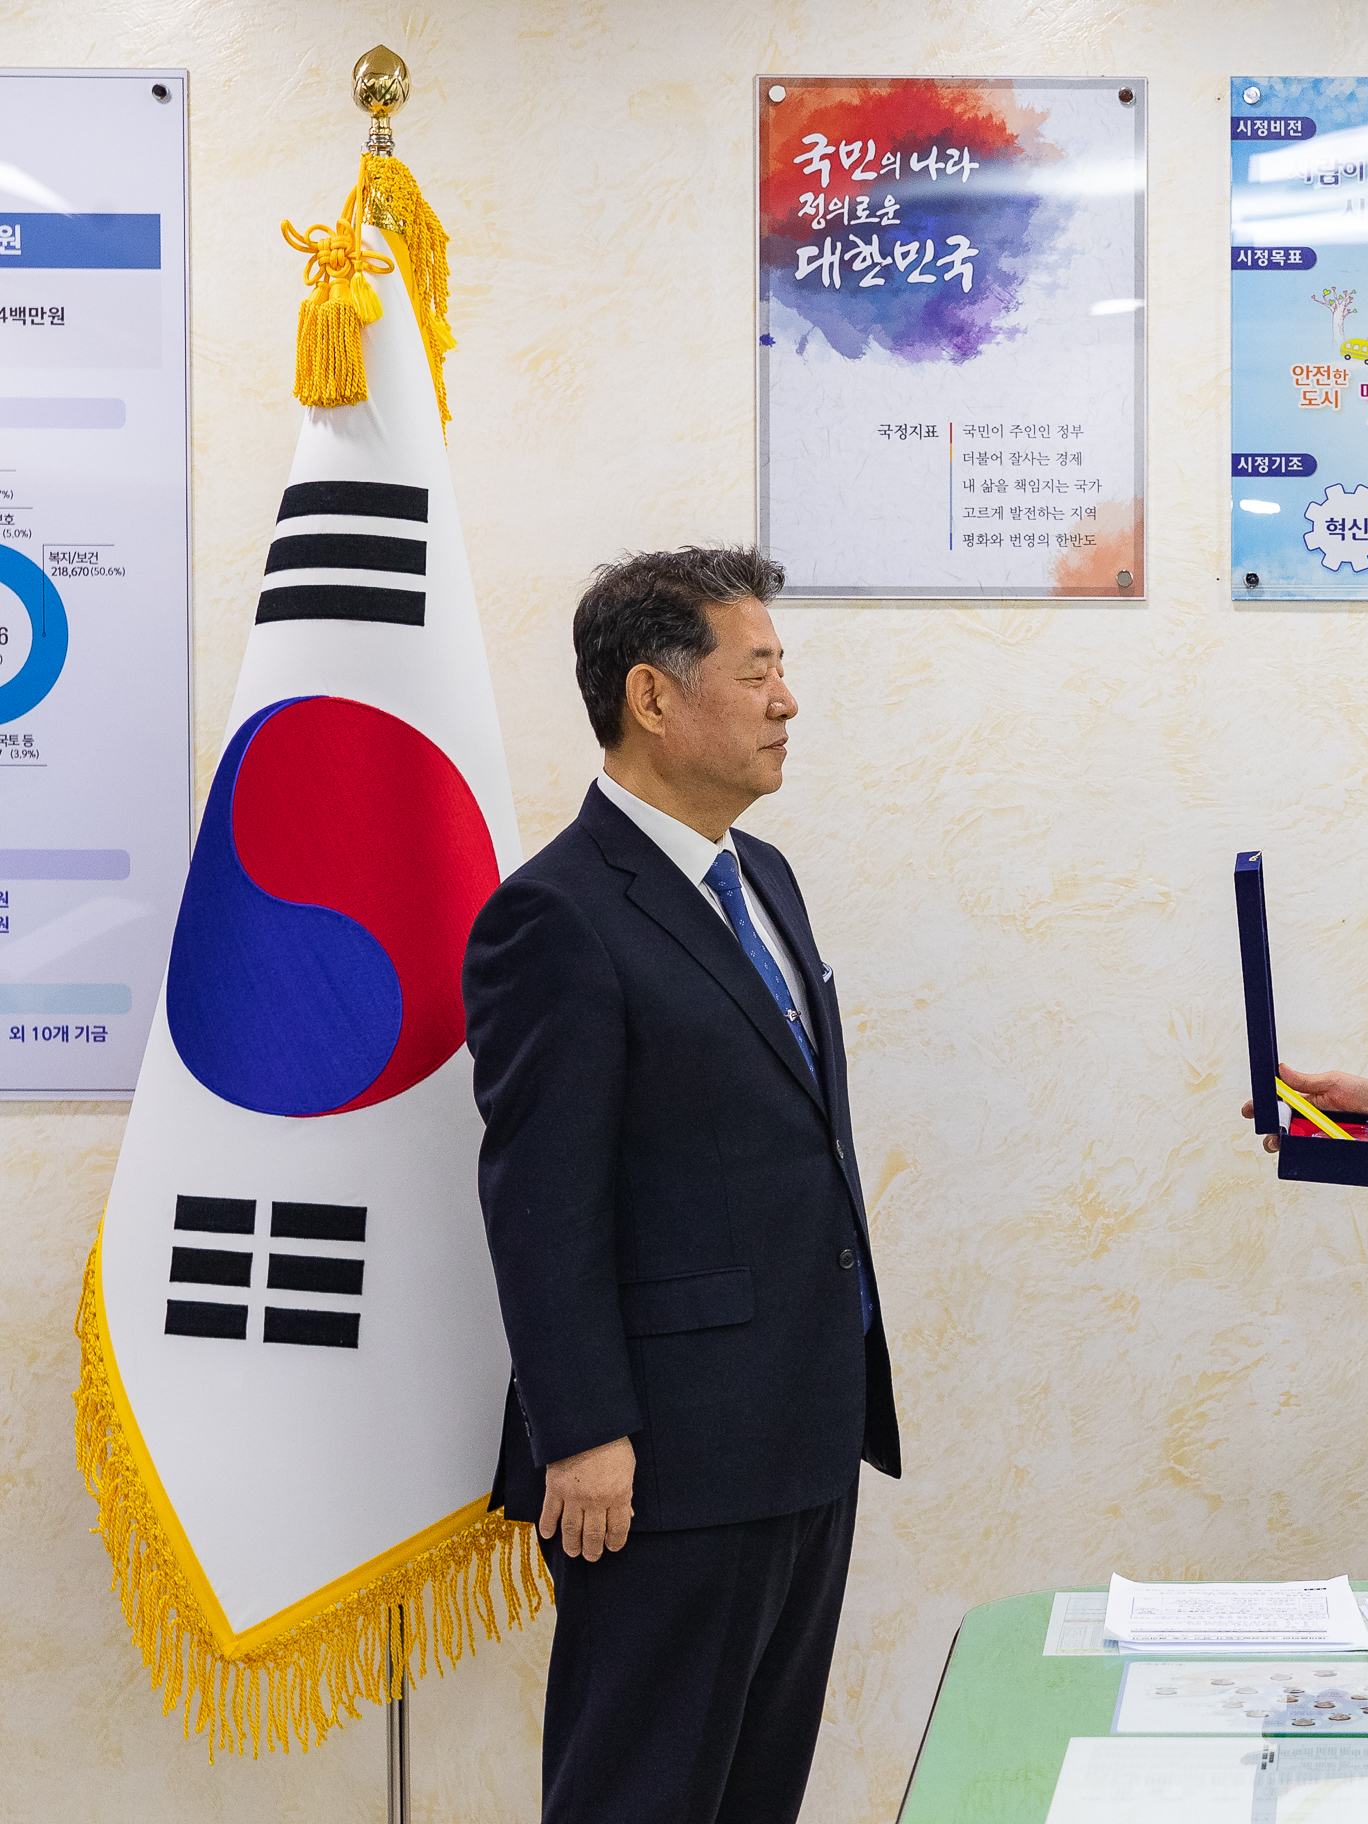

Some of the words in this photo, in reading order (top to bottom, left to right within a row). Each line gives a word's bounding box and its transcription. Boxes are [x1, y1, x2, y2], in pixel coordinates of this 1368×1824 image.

[1237, 119, 1302, 137] 시정비전
[794, 133, 900, 188] 국민의
[910, 146, 979, 182] 나라
[798, 192, 901, 229] 정의로운
[795, 234, 979, 292] 대한민국
[1237, 249, 1303, 267] 시정목표
[1292, 364, 1348, 387] 안전한
[1301, 390, 1340, 408] 도시
[877, 424, 939, 440] 국정지표
[963, 424, 1004, 440] 국민이
[1009, 424, 1051, 440] 주인인
[1056, 424, 1084, 440] 정부
[963, 451, 1003, 467] 더불어
[1009, 451, 1051, 467] 잘사는
[1056, 451, 1082, 467] 경제
[1238, 456, 1303, 473] 시정기조
[963, 478, 975, 494] 내
[980, 478, 1009, 494] 삶을
[1014, 478, 1069, 494] 책임지는
[1074, 478, 1102, 494] 국가
[963, 505, 1004, 521] 고르게
[1009, 505, 1065, 521] 발전하는
[1070, 505, 1096, 521] 지역
[3, 528, 32, 539] (5.0%)
[1325, 518, 1368, 540] 혁신
[963, 532, 1004, 549] 평화와
[1009, 532, 1049, 549] 번영의
[1056, 532, 1097, 549] 한반도
[49, 551, 99, 564] 복지/보건
[22, 734, 34, 747] 등
[10, 749, 39, 759] (3.9%)
[9, 1025, 25, 1042] 외
[32, 1025, 69, 1042] 10개
[75, 1025, 108, 1042] 기금
